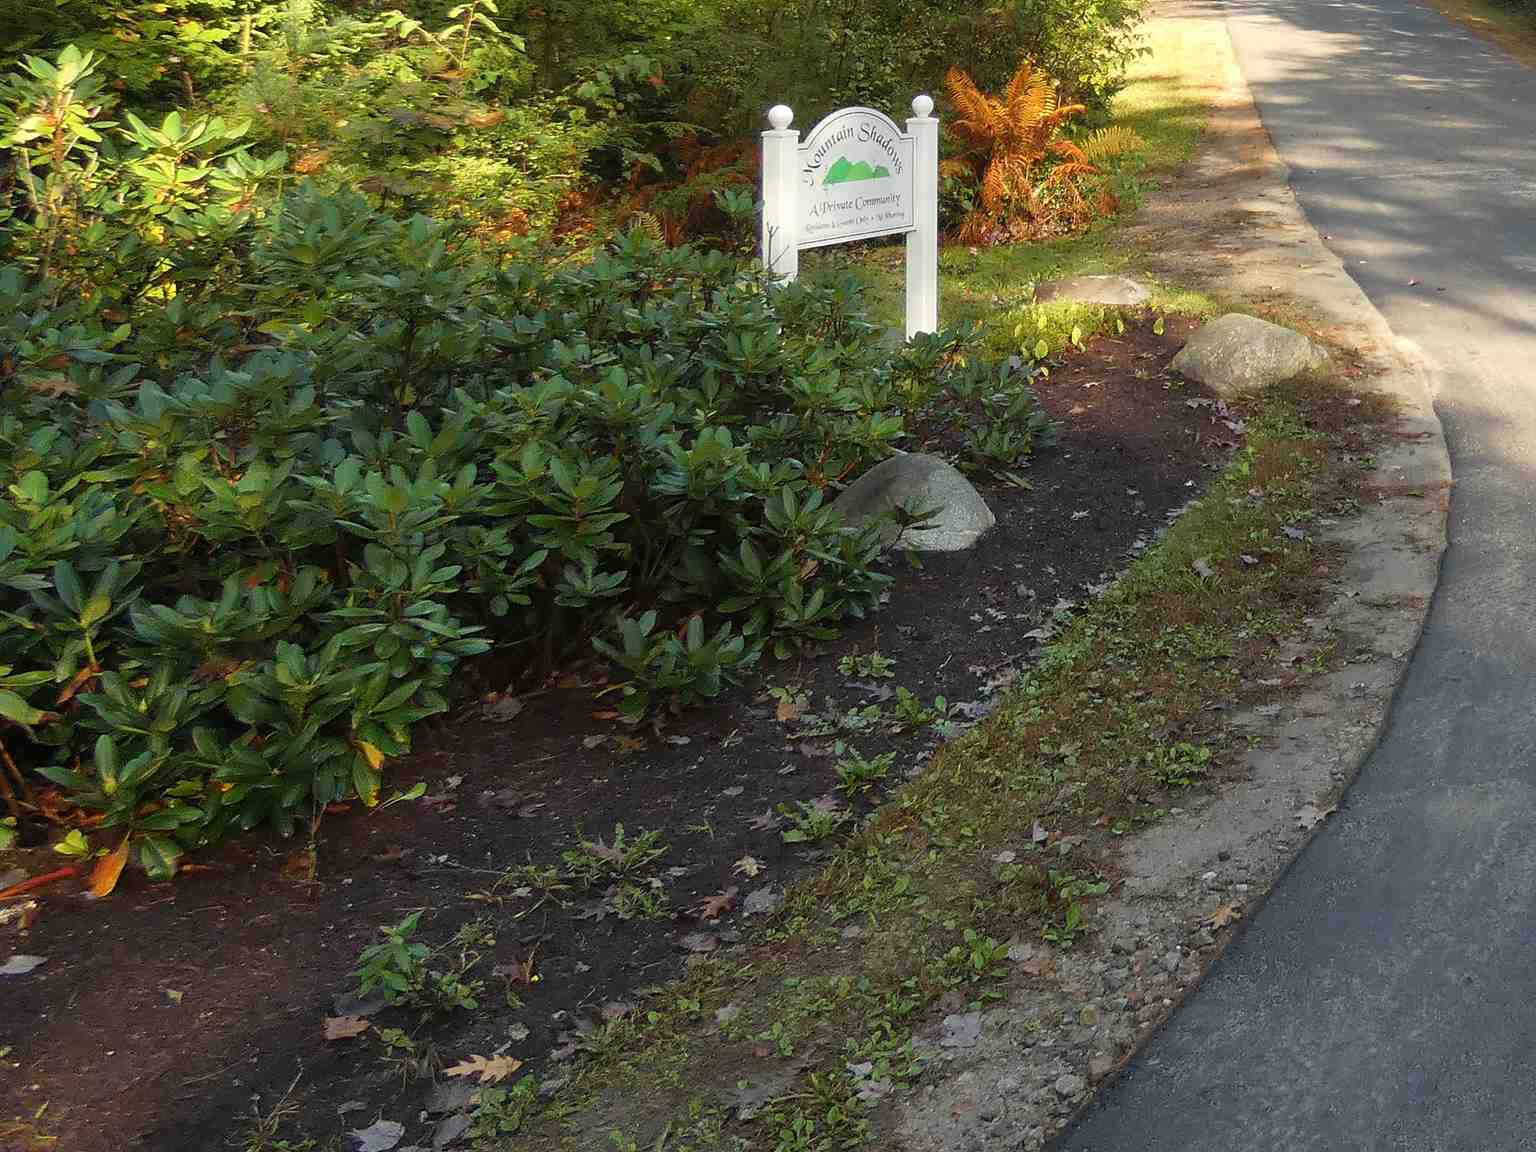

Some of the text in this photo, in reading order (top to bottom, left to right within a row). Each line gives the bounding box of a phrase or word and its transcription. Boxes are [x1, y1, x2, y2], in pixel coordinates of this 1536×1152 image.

[802, 122, 904, 186] Mountain Shadows
[808, 193, 901, 217] A Private Community
